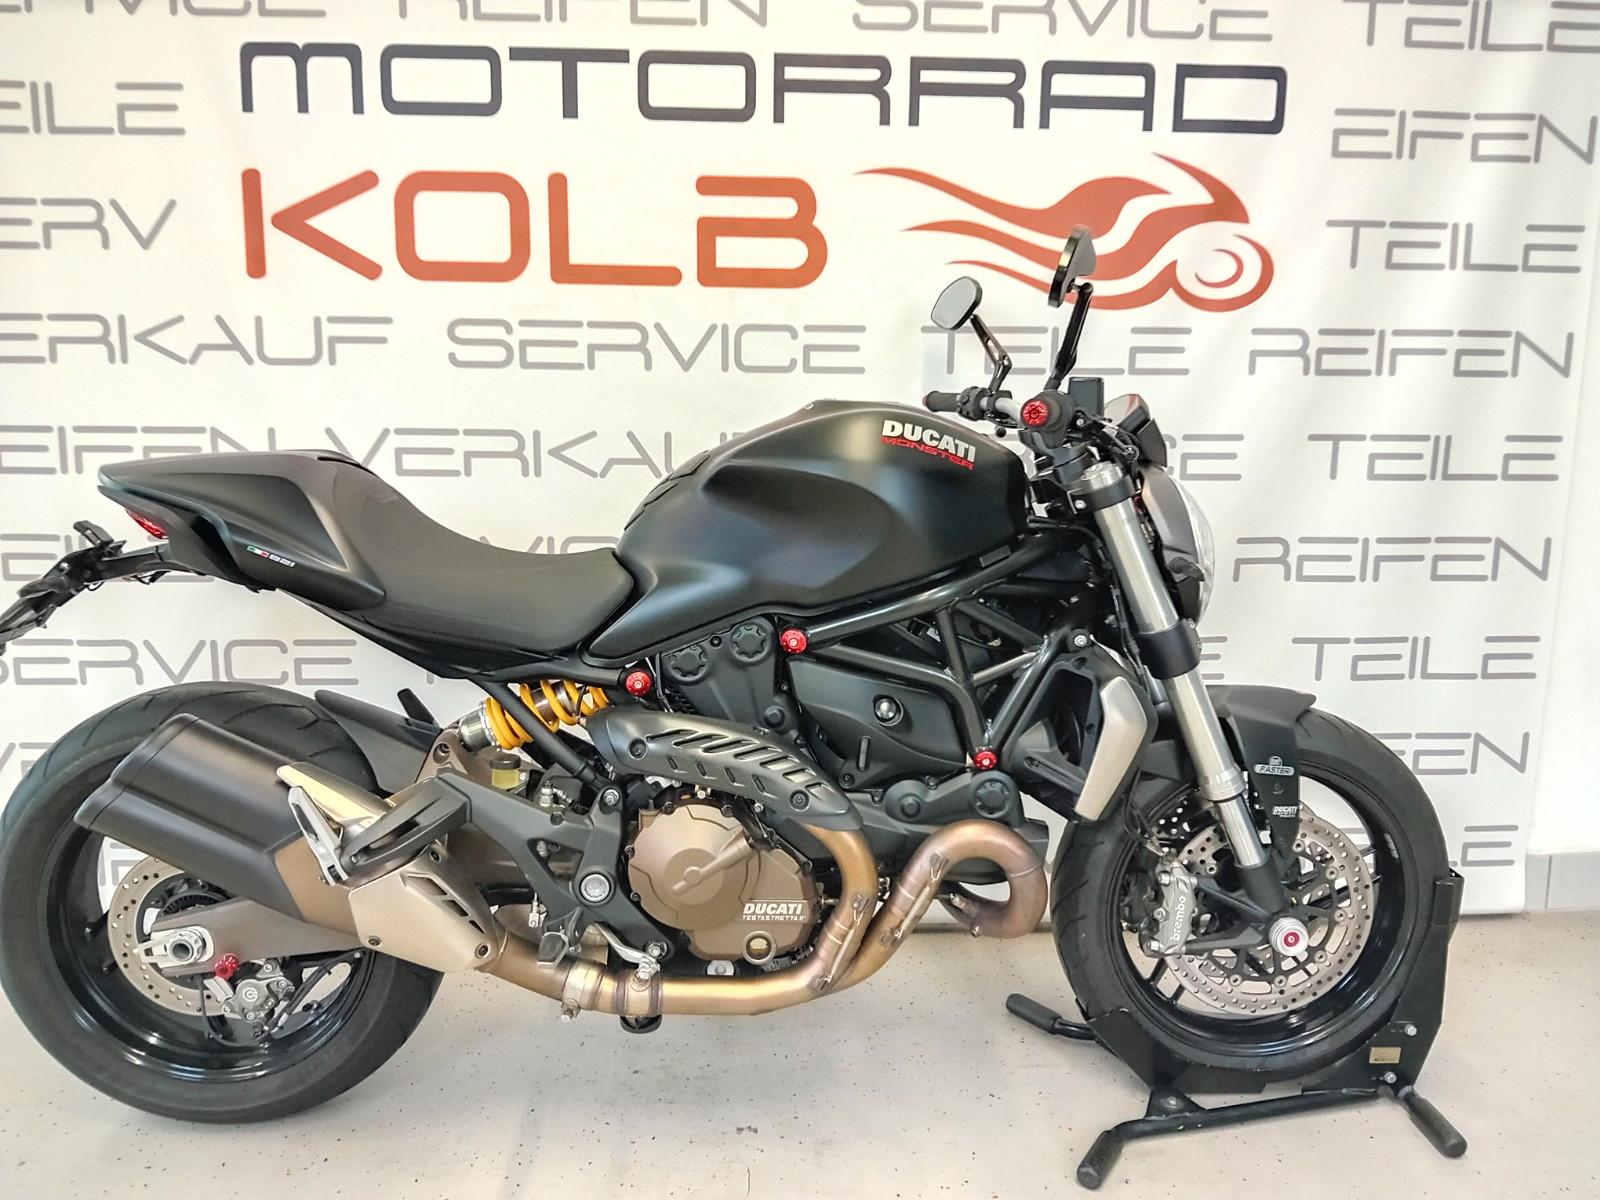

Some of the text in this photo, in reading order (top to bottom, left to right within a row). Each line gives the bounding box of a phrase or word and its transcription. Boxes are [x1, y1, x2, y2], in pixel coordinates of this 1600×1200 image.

[240, 41, 1287, 134] MOTORRAD
[1331, 107, 1598, 164] EIFEN
[241, 168, 828, 288] KOLB
[1326, 219, 1586, 273] TEILE
[447, 317, 866, 375] SERVICE
[1248, 327, 1574, 378] REIFEN
[882, 420, 976, 462] DUCATI
[1307, 433, 1564, 481] TEILE
[1232, 536, 1553, 582] REIFEN
[0, 638, 358, 686] ERVICE
[1291, 635, 1542, 681] TEILE
[743, 903, 803, 914] DUCATI
[1170, 896, 1186, 940] brembo
